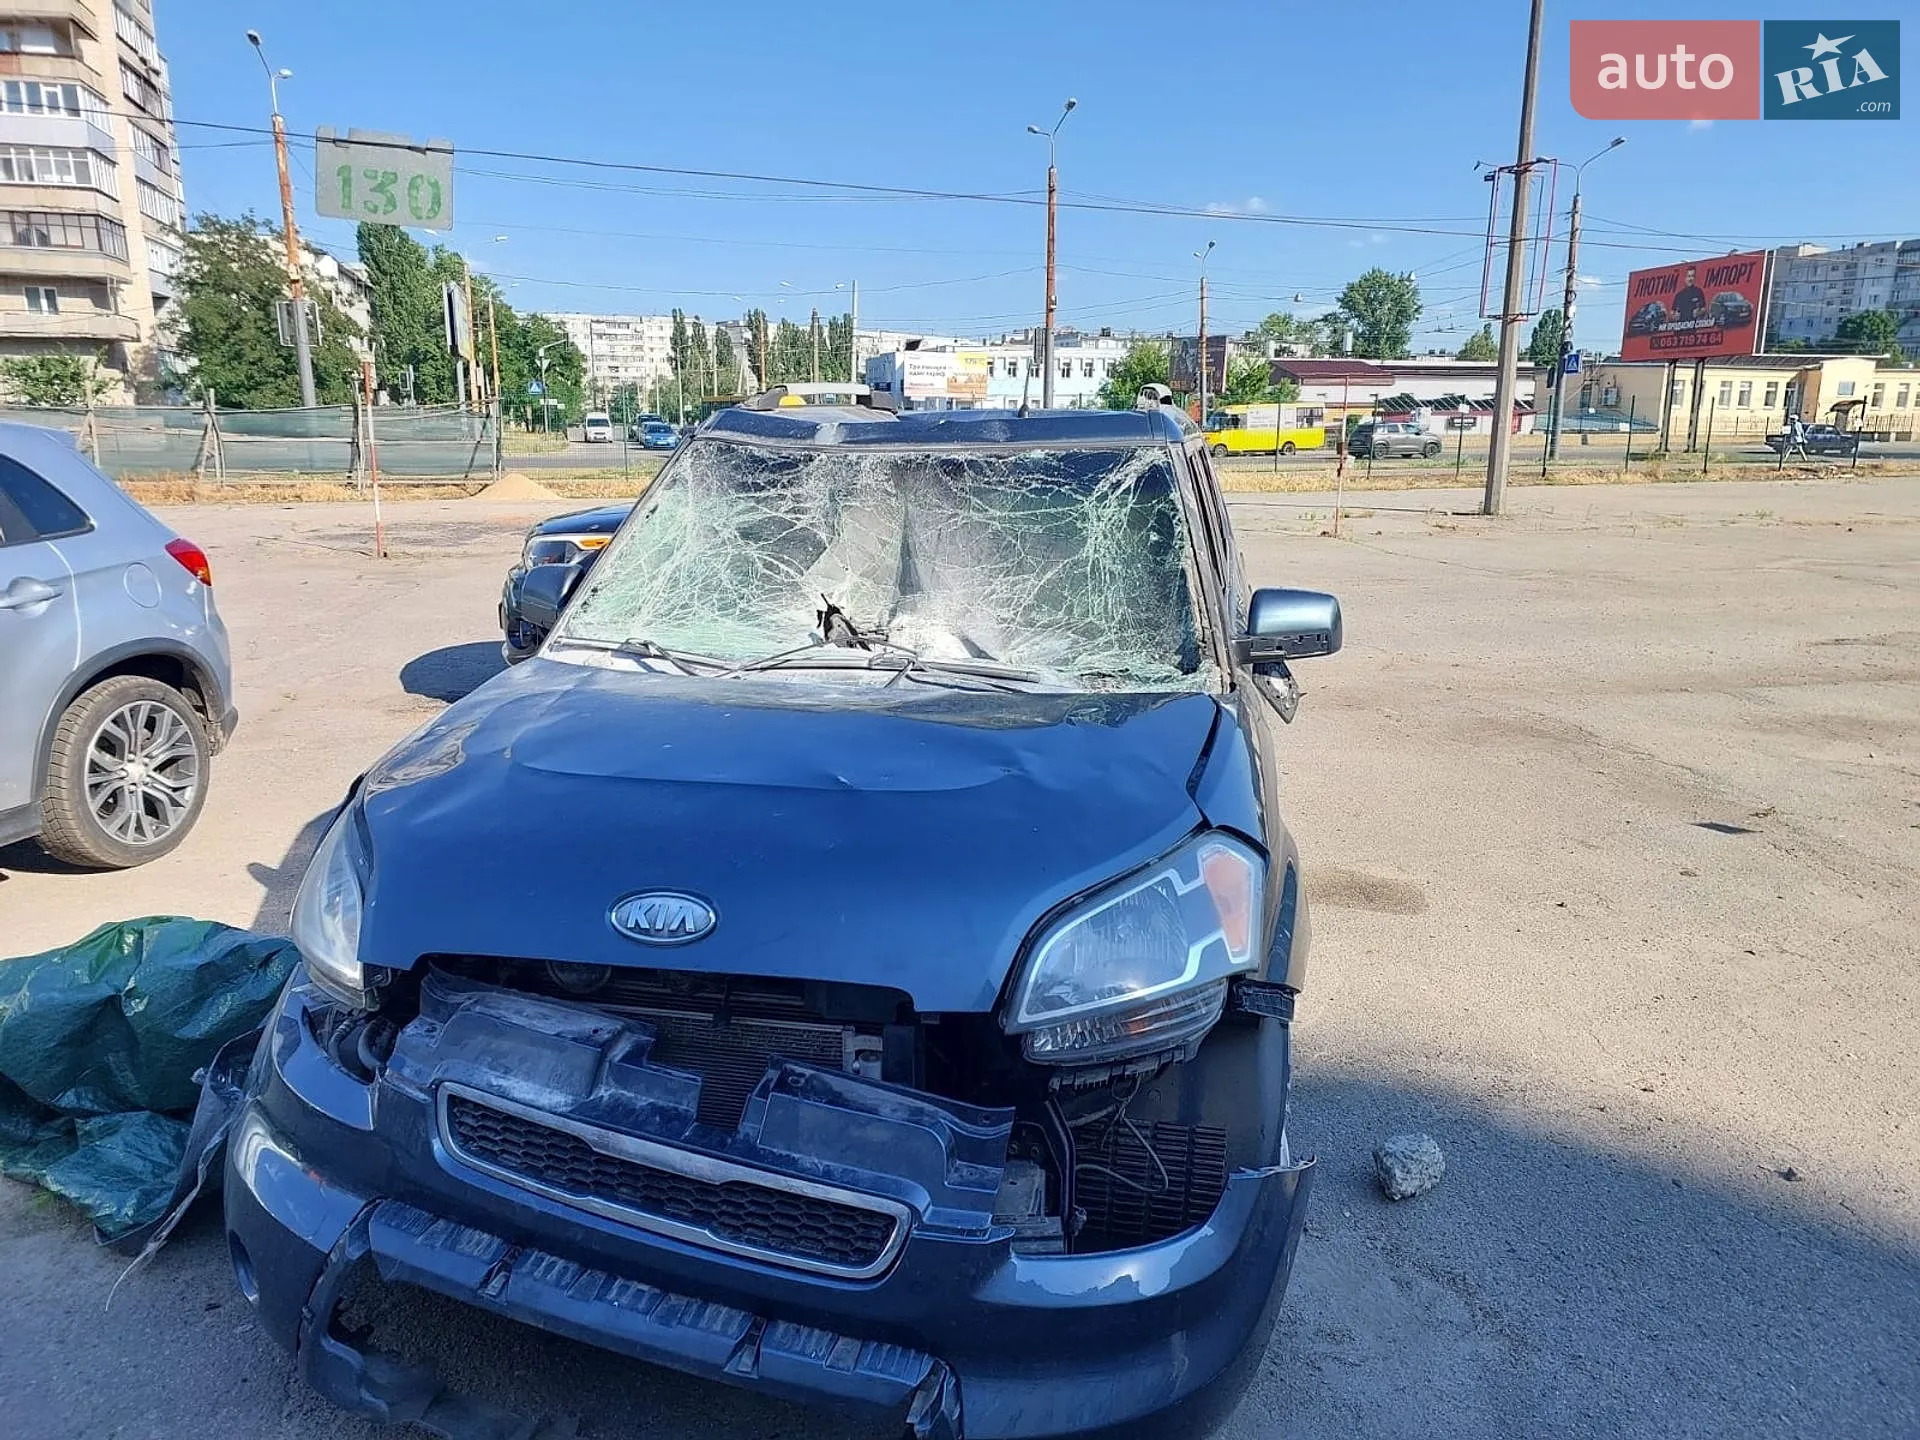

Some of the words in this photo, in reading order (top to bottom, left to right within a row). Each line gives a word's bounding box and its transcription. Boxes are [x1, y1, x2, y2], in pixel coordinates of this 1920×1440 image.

[336, 164, 442, 220] 130
[1634, 269, 1680, 298] ЛЮТИЙ
[1703, 262, 1758, 289] ІМПОРТ
[626, 903, 696, 932] KIA
